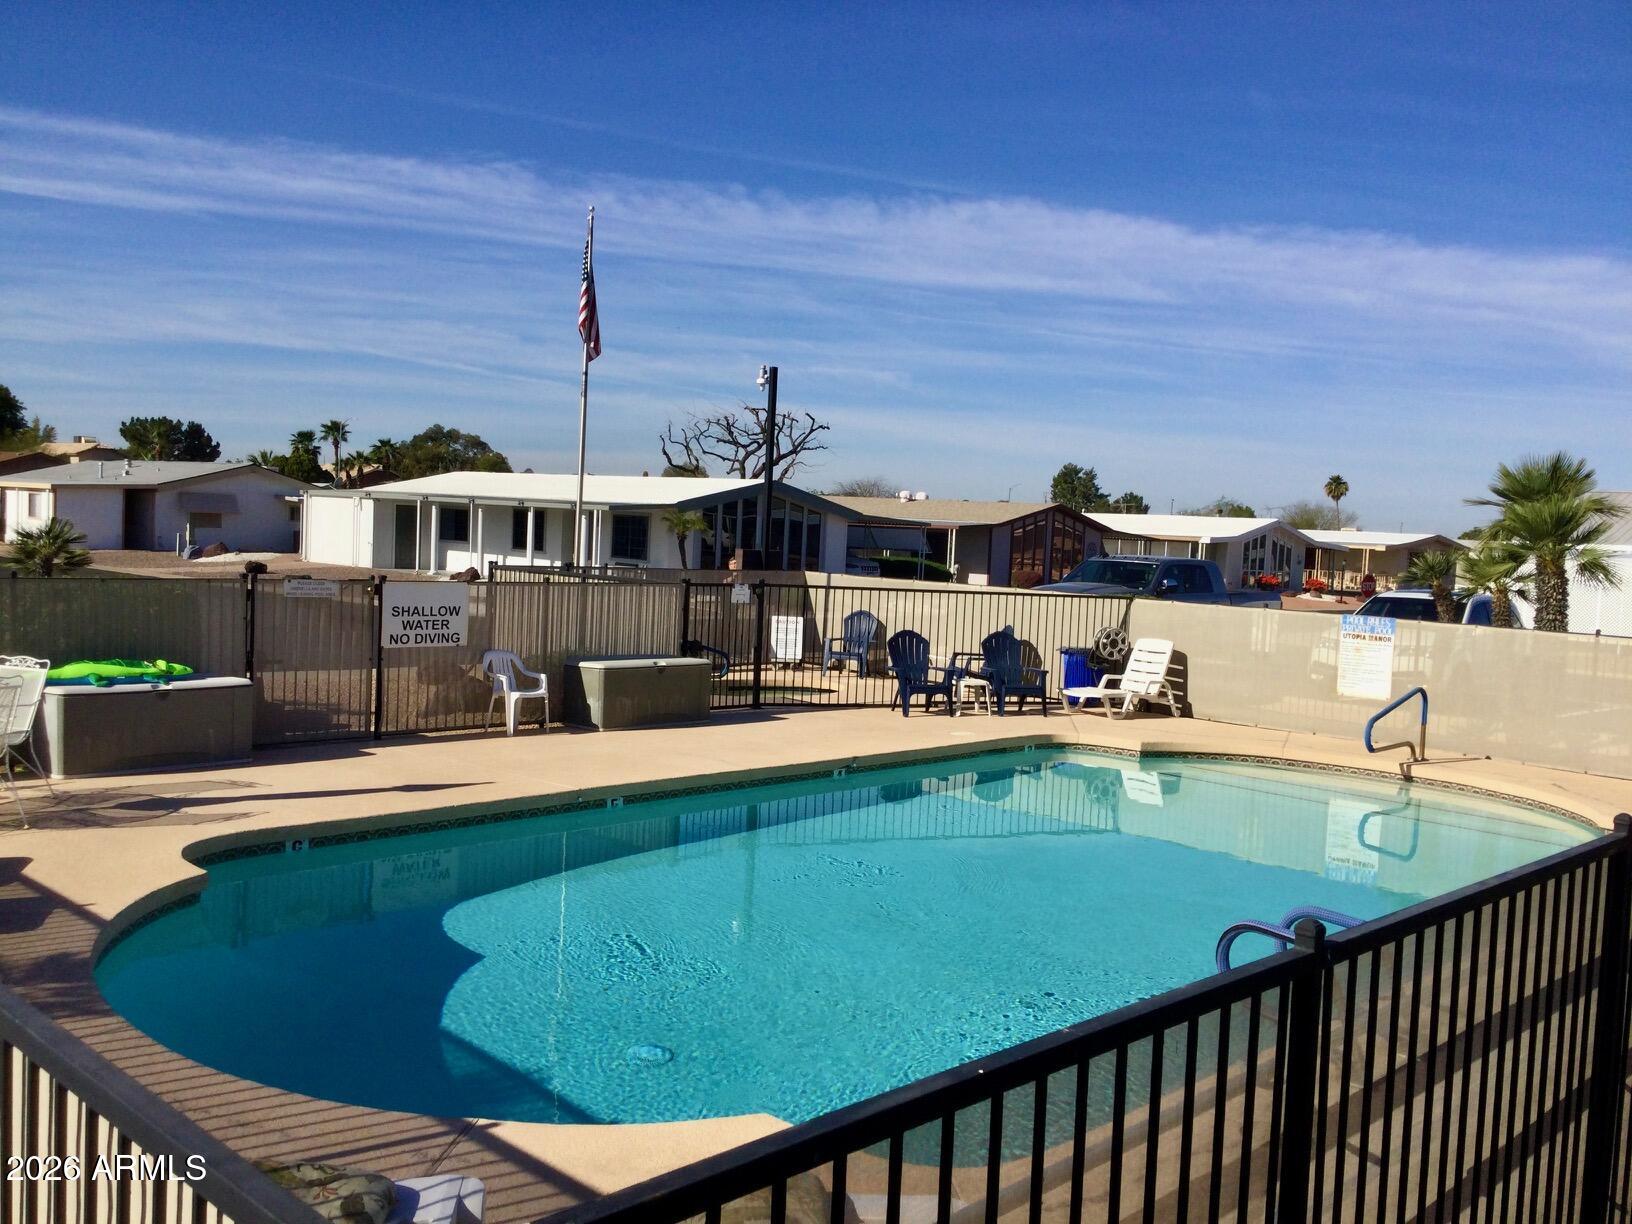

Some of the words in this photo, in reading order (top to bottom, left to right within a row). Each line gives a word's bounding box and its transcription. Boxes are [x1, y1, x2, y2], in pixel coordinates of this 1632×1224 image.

[391, 606, 461, 617] SHALLOW
[401, 619, 450, 631] WATER
[1347, 616, 1363, 625] POOL
[1367, 617, 1391, 627] RULES
[389, 633, 410, 645] NO
[414, 632, 460, 644] DIVING
[1343, 633, 1366, 641] UTOPIA
[1369, 635, 1392, 643] MANOR
